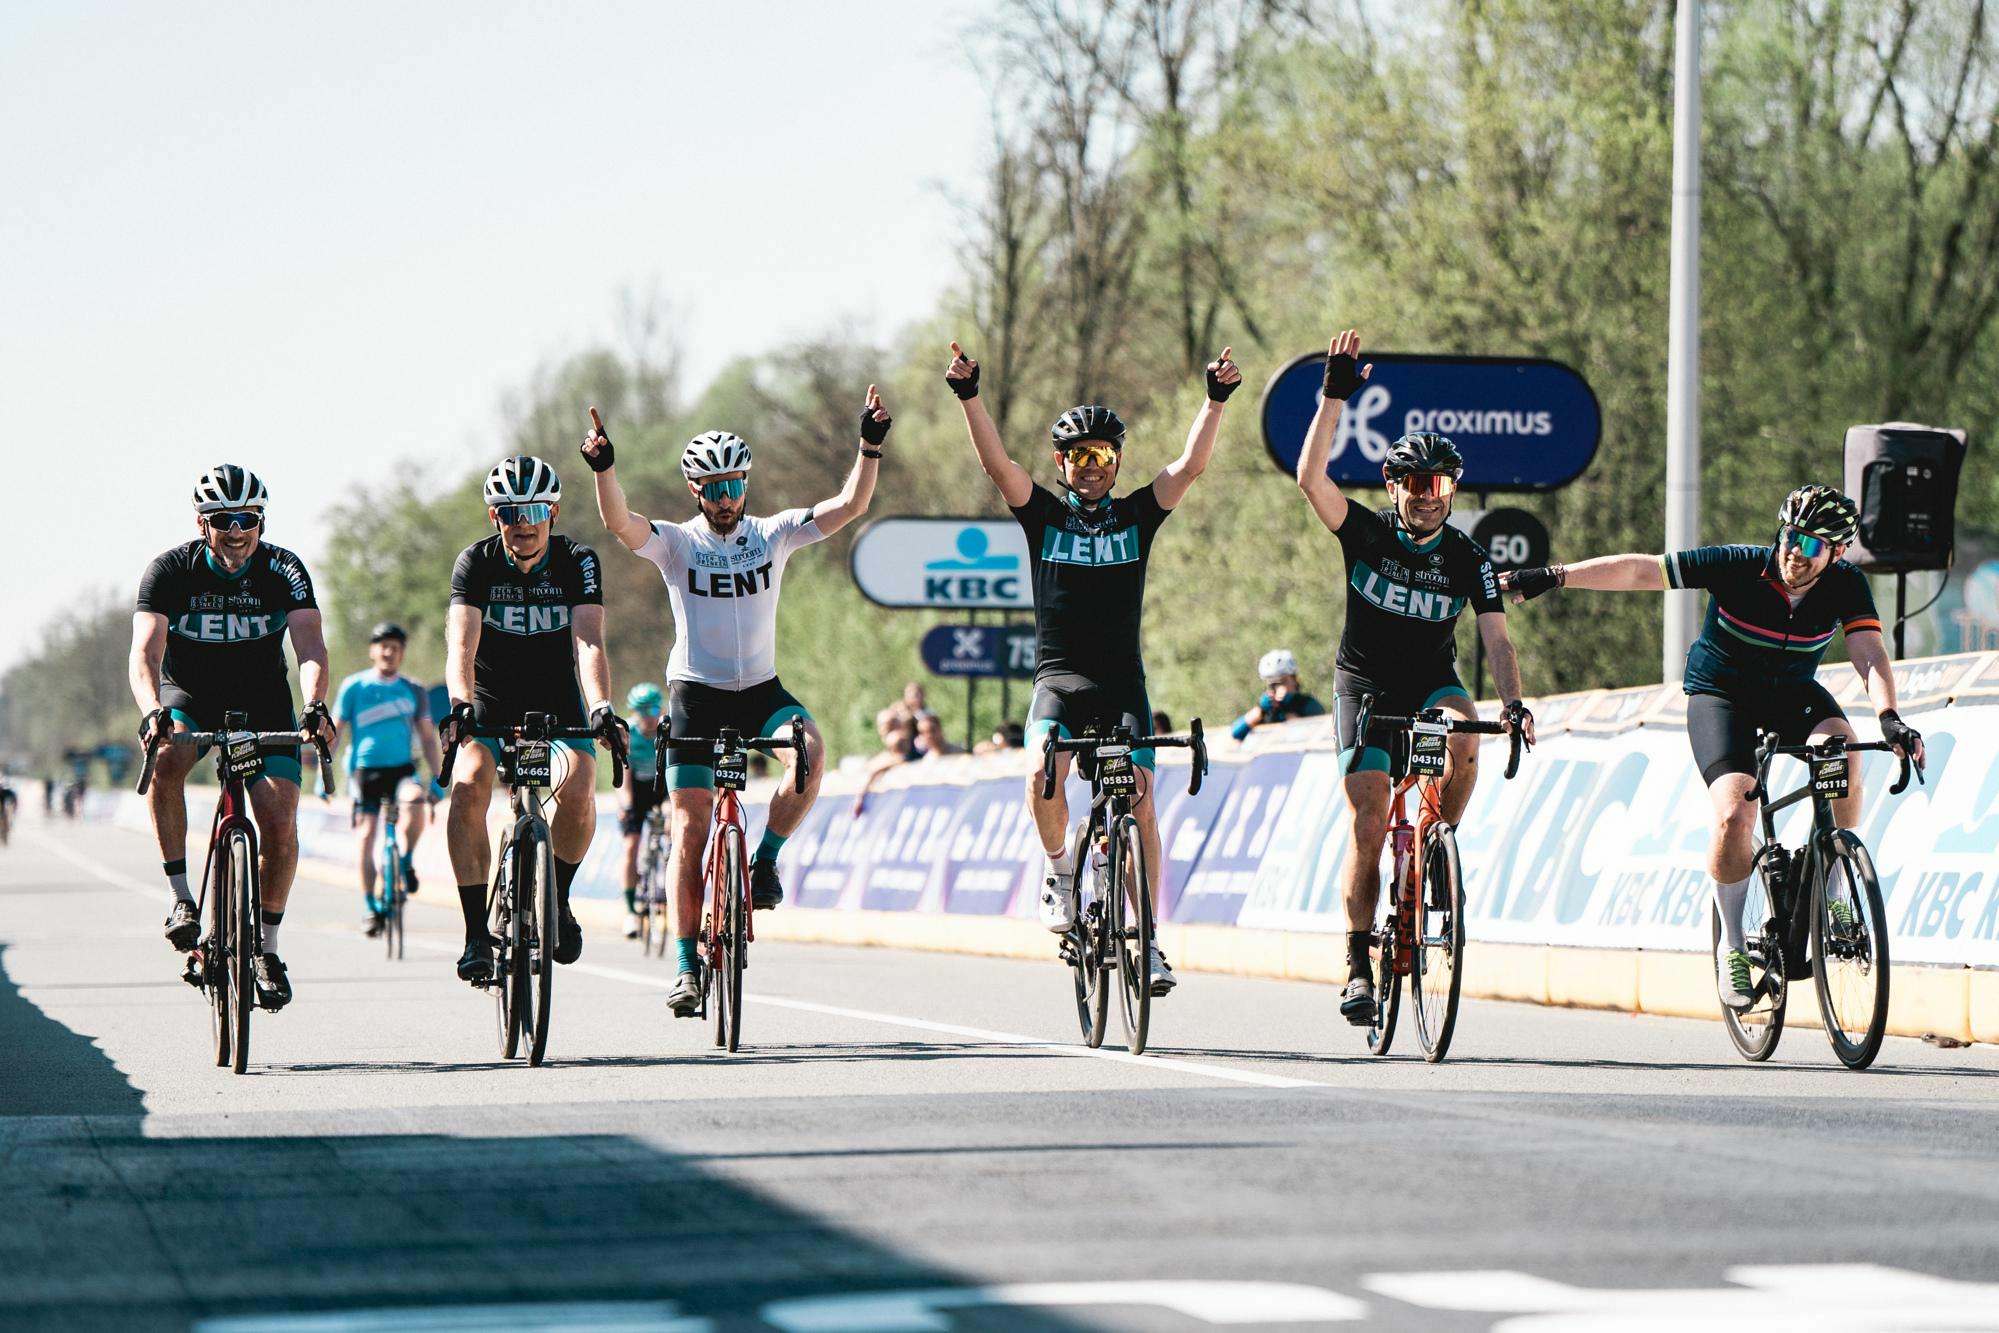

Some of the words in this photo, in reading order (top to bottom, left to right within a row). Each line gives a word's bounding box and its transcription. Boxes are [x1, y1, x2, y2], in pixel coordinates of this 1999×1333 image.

[1404, 409, 1553, 435] proximus
[1051, 531, 1128, 563] LENT
[1489, 535, 1530, 564] 50
[580, 555, 597, 594] Mark
[688, 560, 773, 598] LENT
[1415, 570, 1449, 585] stroom
[1480, 561, 1497, 599] Stan
[925, 577, 1018, 600] KBC
[1363, 571, 1453, 619] LENT
[178, 613, 271, 640] LENT
[483, 605, 569, 632] LENT
[1006, 636, 1036, 670] 75
[231, 757, 262, 772] 06401
[517, 767, 550, 776] 04662
[1411, 754, 1444, 766] 04310
[716, 769, 746, 781] 03274
[1102, 775, 1135, 785] 05833
[1815, 779, 1848, 790] 06118
[1896, 871, 1984, 940] KBC
